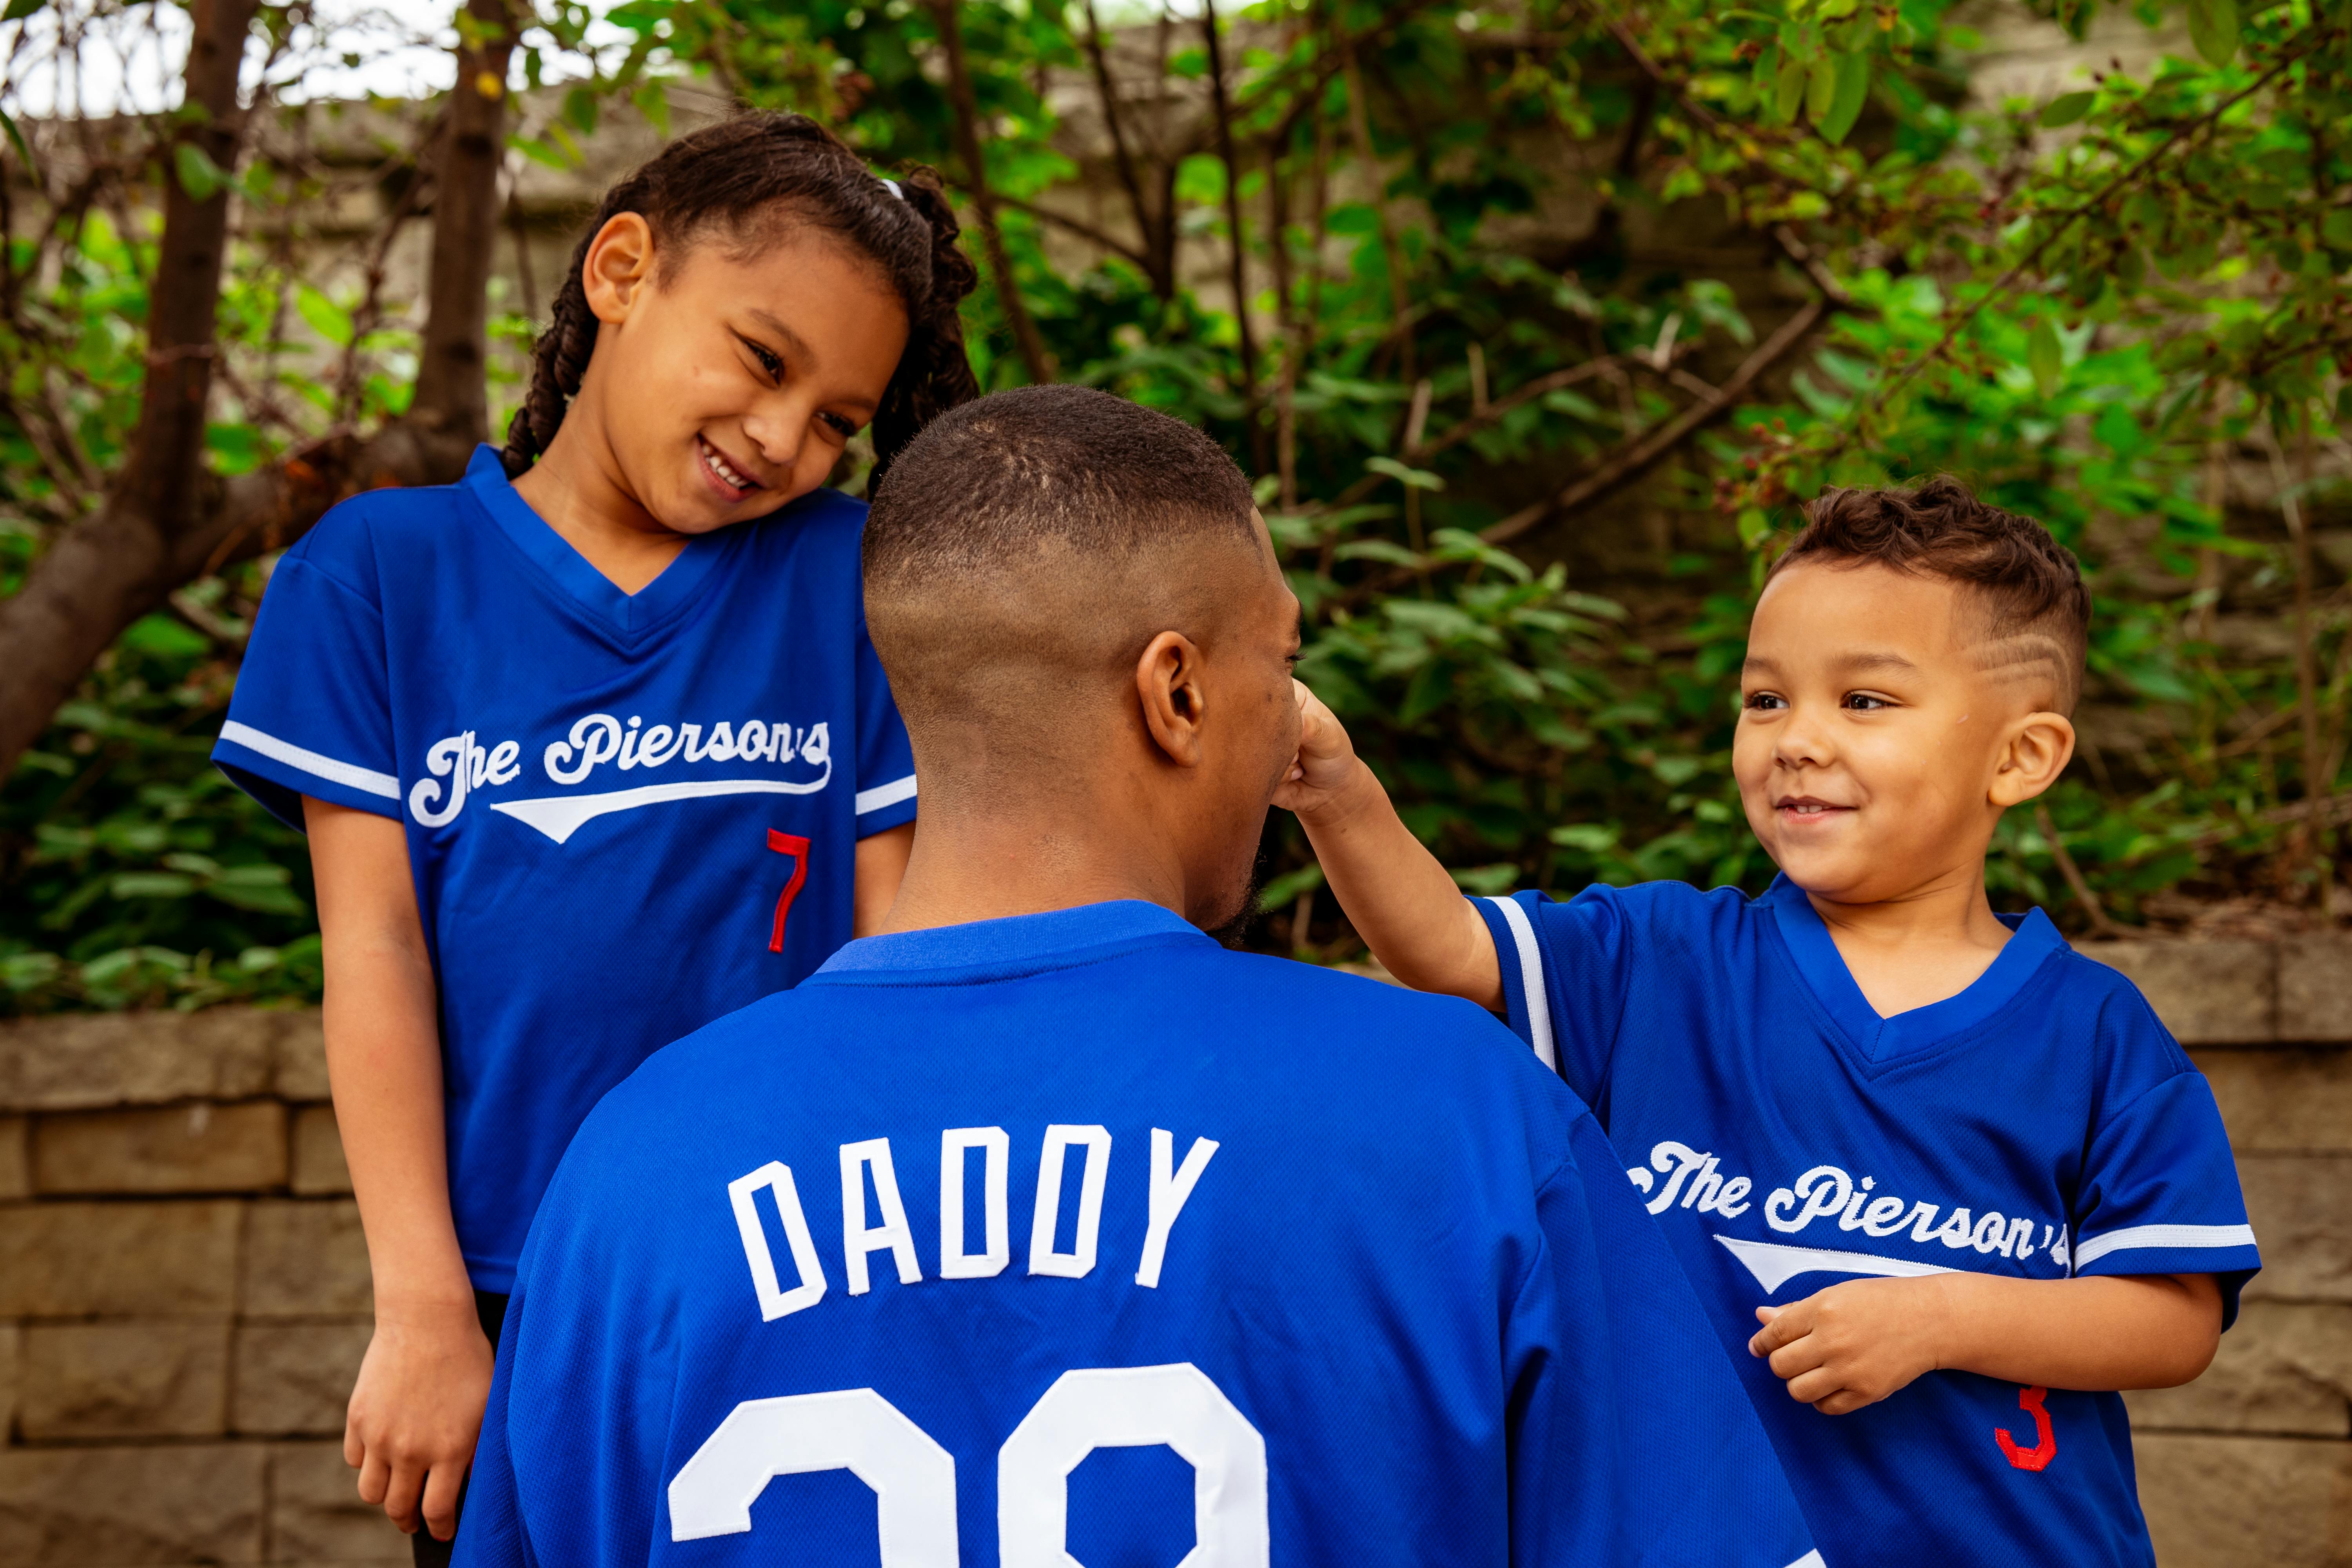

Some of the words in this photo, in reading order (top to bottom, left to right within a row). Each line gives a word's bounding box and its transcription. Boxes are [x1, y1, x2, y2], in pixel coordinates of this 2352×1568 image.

[409, 730, 521, 827] The
[544, 713, 831, 785] Pierson's
[768, 828, 811, 953] 7
[727, 1124, 1220, 1323] DADDY
[1626, 1140, 1752, 1219] The
